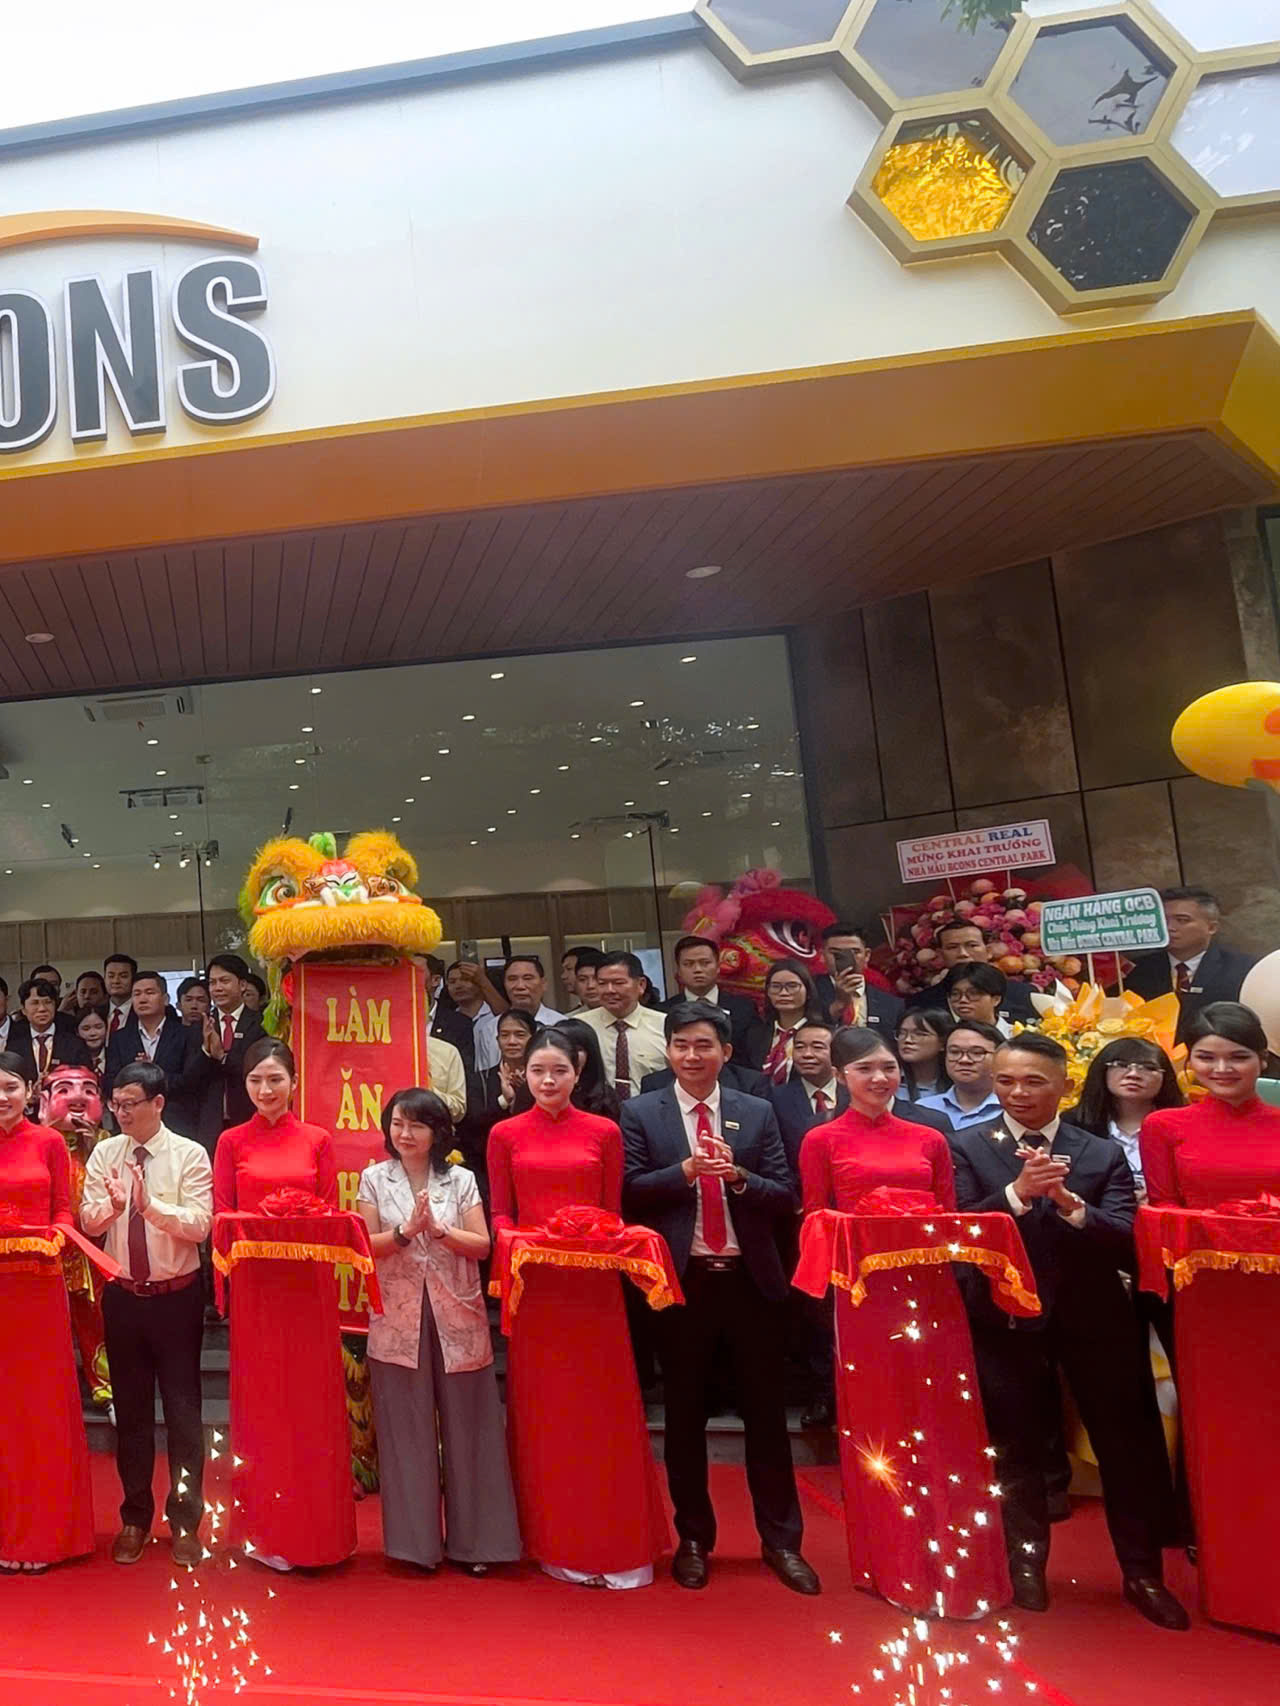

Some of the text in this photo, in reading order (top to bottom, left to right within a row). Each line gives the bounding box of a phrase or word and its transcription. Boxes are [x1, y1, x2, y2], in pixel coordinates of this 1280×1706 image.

[912, 827, 1033, 853] CENTRAL REAL
[947, 847, 981, 859] KHAI
[978, 853, 1019, 868] CENTRAL
[1021, 849, 1047, 863] PARK
[1125, 894, 1156, 912] OCB
[326, 986, 392, 1044] LÀM
[336, 1068, 382, 1131] ĂN
